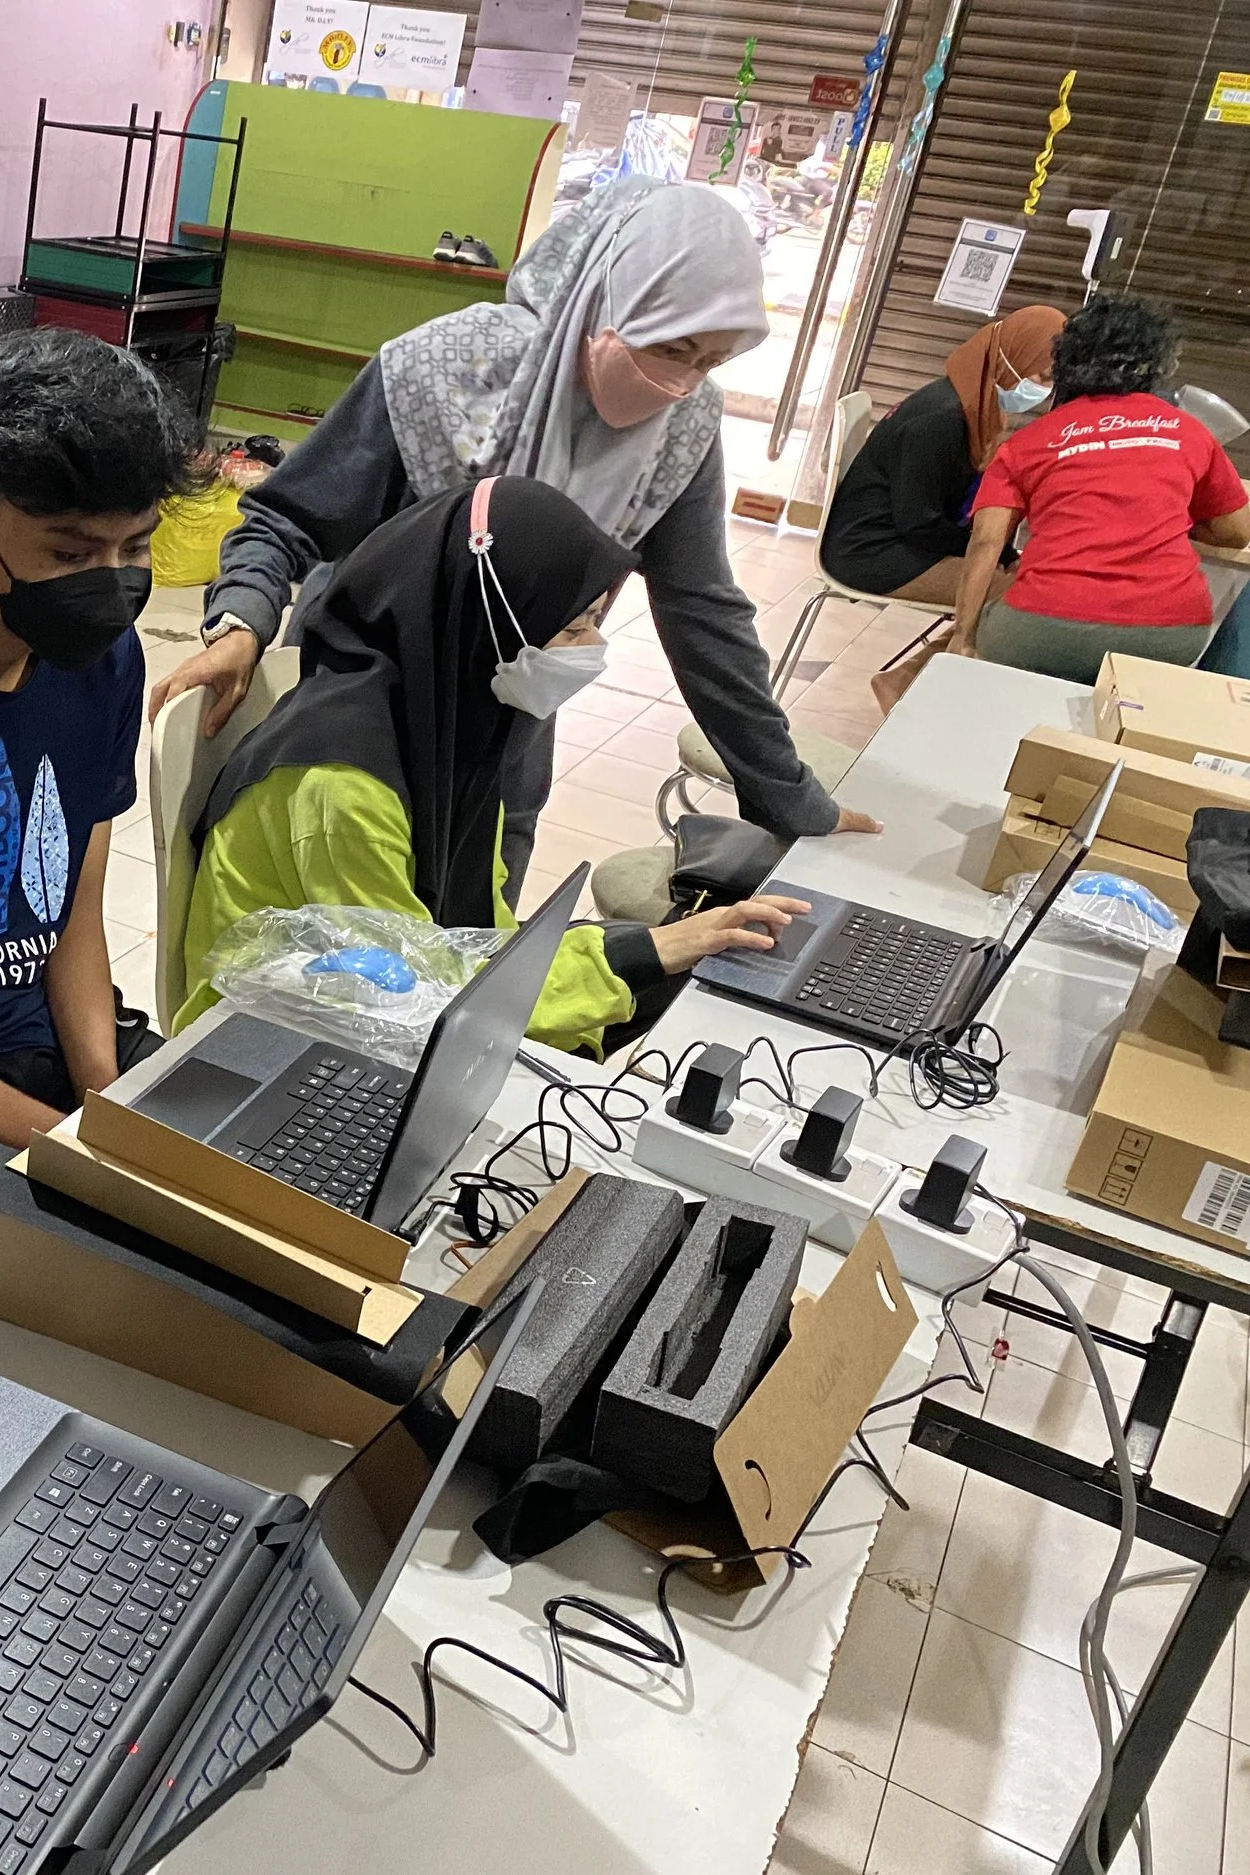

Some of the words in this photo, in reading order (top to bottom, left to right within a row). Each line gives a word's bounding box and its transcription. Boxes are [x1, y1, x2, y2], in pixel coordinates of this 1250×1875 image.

[306, 5, 324, 13] Thank
[401, 23, 418, 31] Thank
[831, 118, 846, 152] PULL
[1047, 421, 1094, 448] Jam
[1098, 415, 1180, 432] Breakfast
